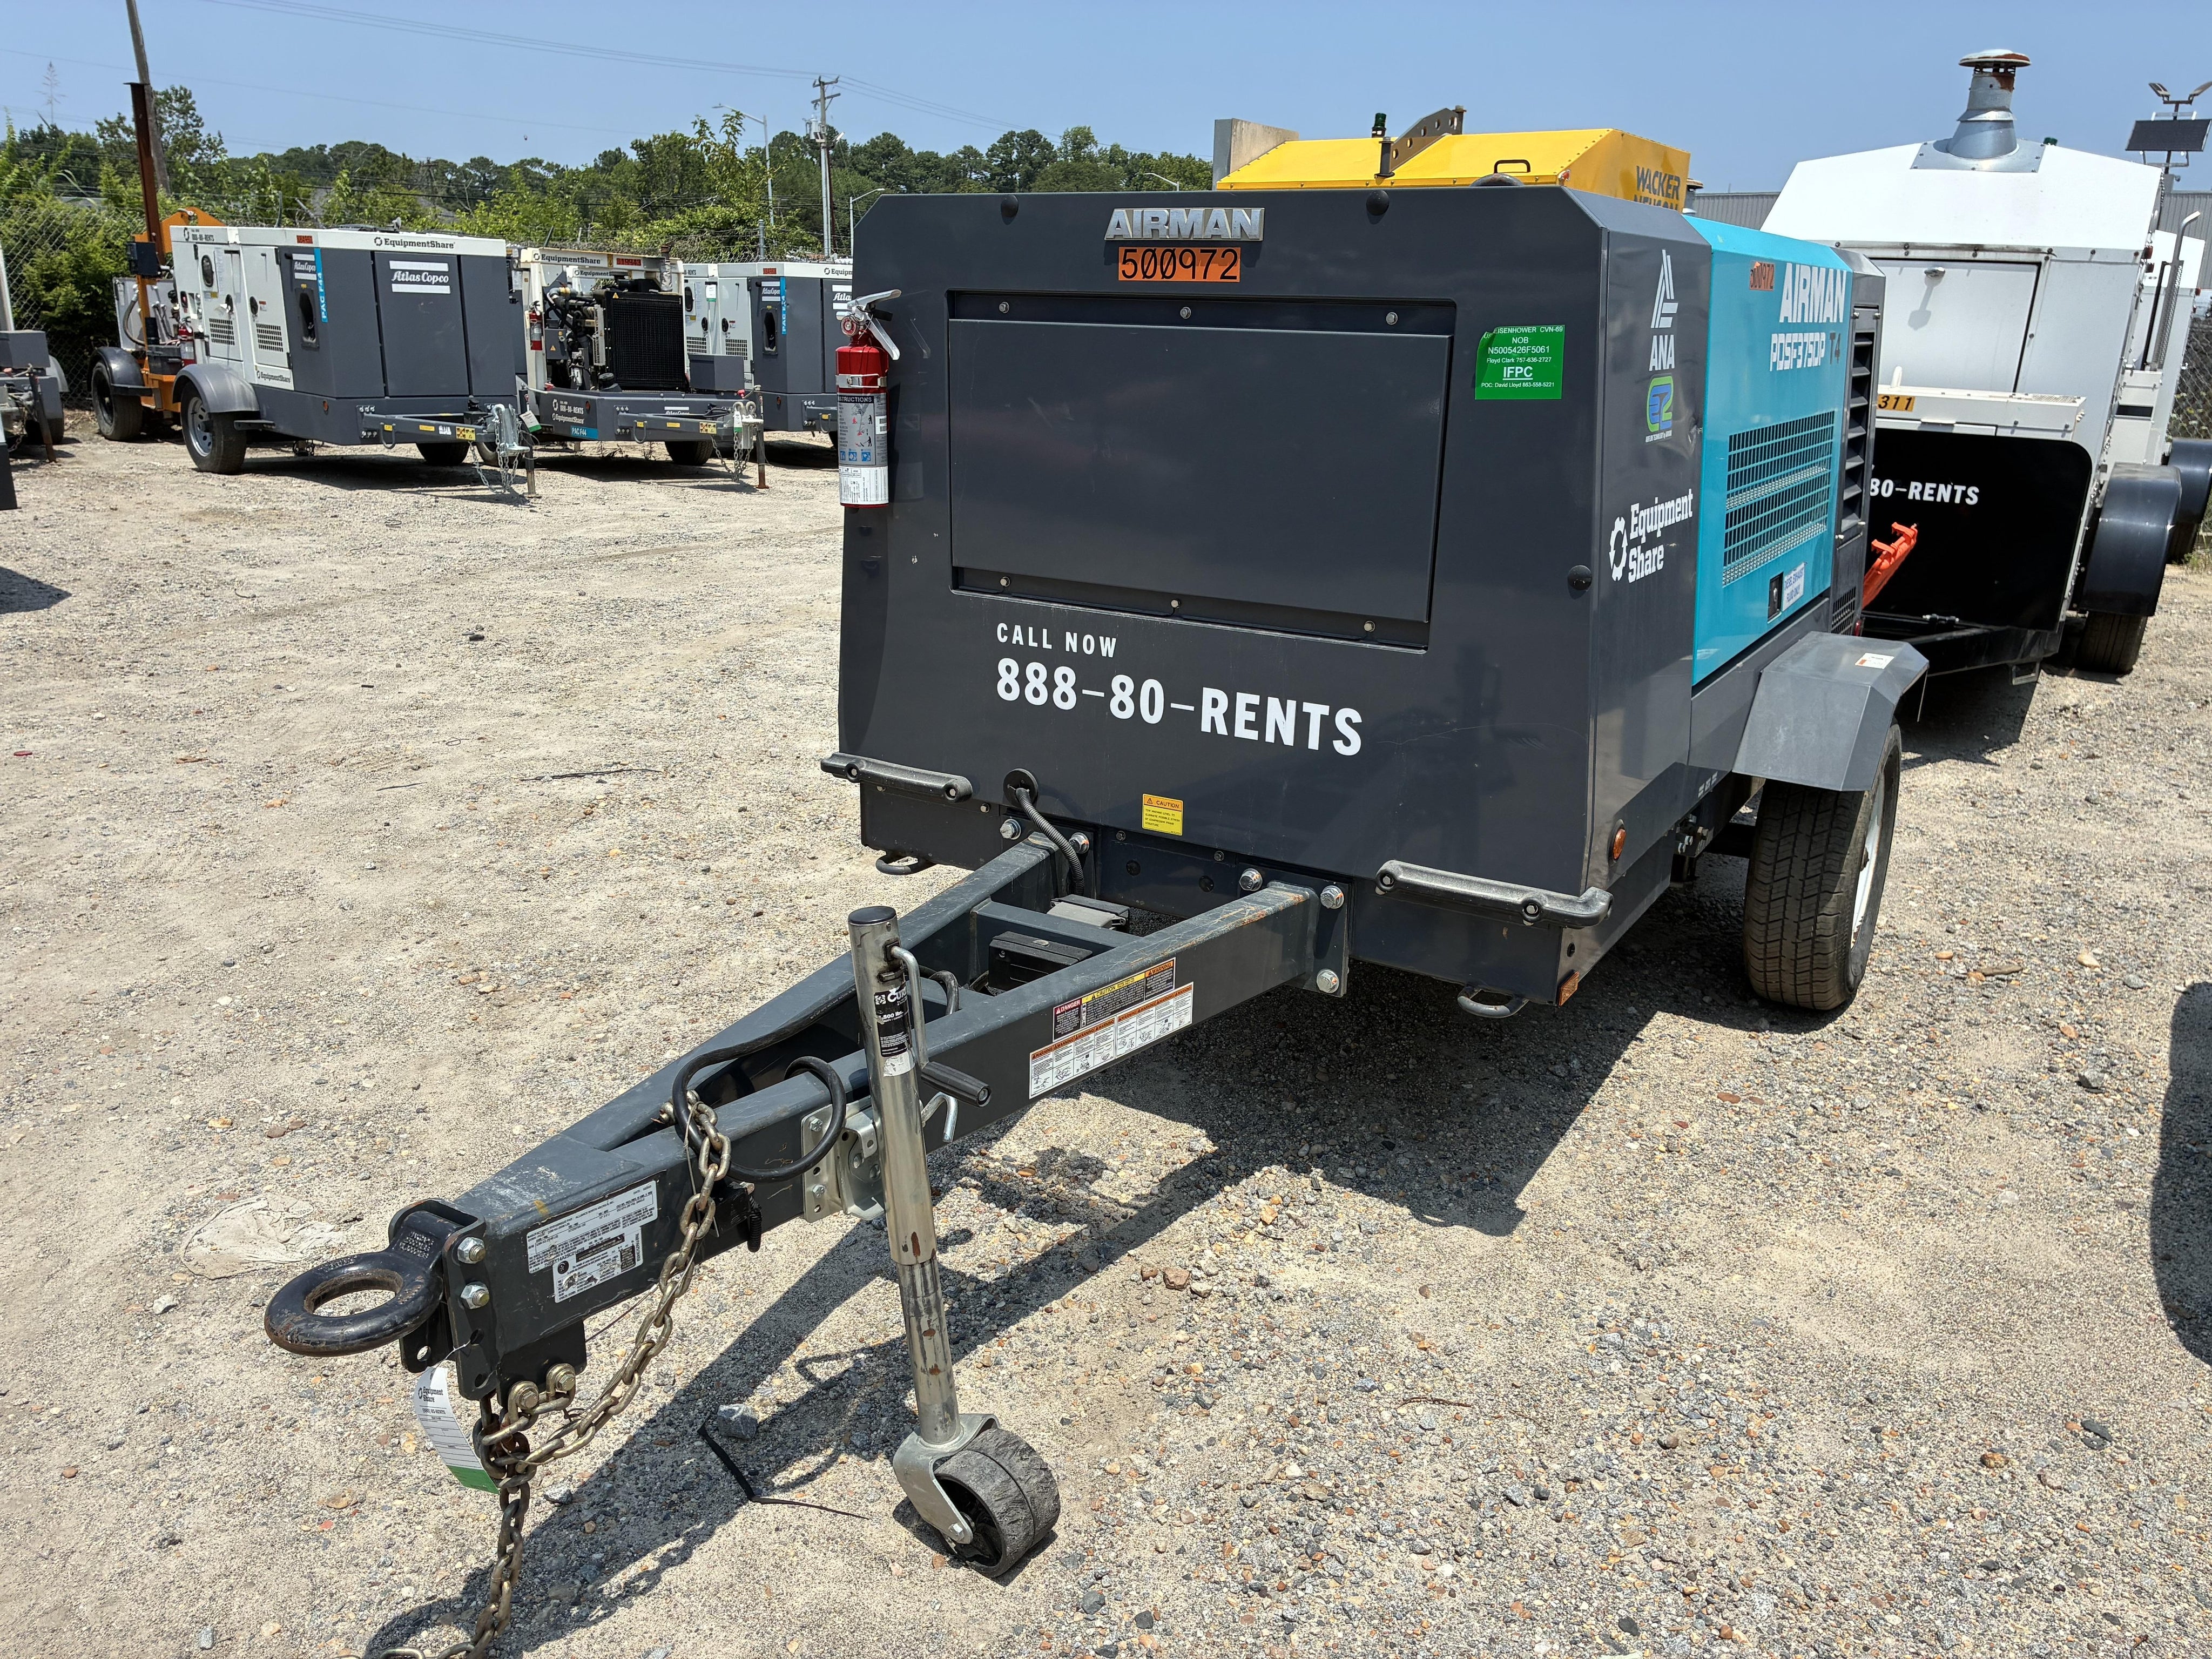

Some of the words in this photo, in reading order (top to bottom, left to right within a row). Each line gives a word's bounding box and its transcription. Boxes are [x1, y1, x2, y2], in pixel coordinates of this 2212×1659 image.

[1636, 165, 1680, 200] WACKER
[1106, 208, 1263, 239] AIRMAN
[384, 238, 455, 249] EquipmentShare
[541, 254, 601, 264] EquipmentShare
[1121, 248, 1238, 280] 500972
[392, 271, 421, 282] Atlas
[422, 272, 449, 284] Copco
[1779, 262, 1846, 323] AIRMAN
[1488, 346, 1549, 354] N5005426F5061
[1649, 334, 1675, 371] ANA
[1830, 332, 1841, 365] T4
[1503, 366, 1533, 378] IFPC
[1878, 395, 1913, 410] 311
[1630, 488, 1693, 544] Equipment
[1628, 544, 1664, 583] Share
[997, 623, 1052, 650] CALL
[1065, 632, 1117, 658] NOW
[997, 658, 1363, 756] 888-80-RENTS
[1156, 800, 1179, 808] CAUTION
[1152, 962, 1171, 975] WARNING
[887, 986, 907, 1002] CUR
[1096, 986, 1116, 997] CAUTION
[1061, 1000, 1080, 1011] DANGER
[1078, 1028, 1094, 1038] WARNING
[1057, 1037, 1074, 1048] WARNING
[1035, 1047, 1053, 1058] WARNING
[423, 1386, 443, 1395] Equipment
